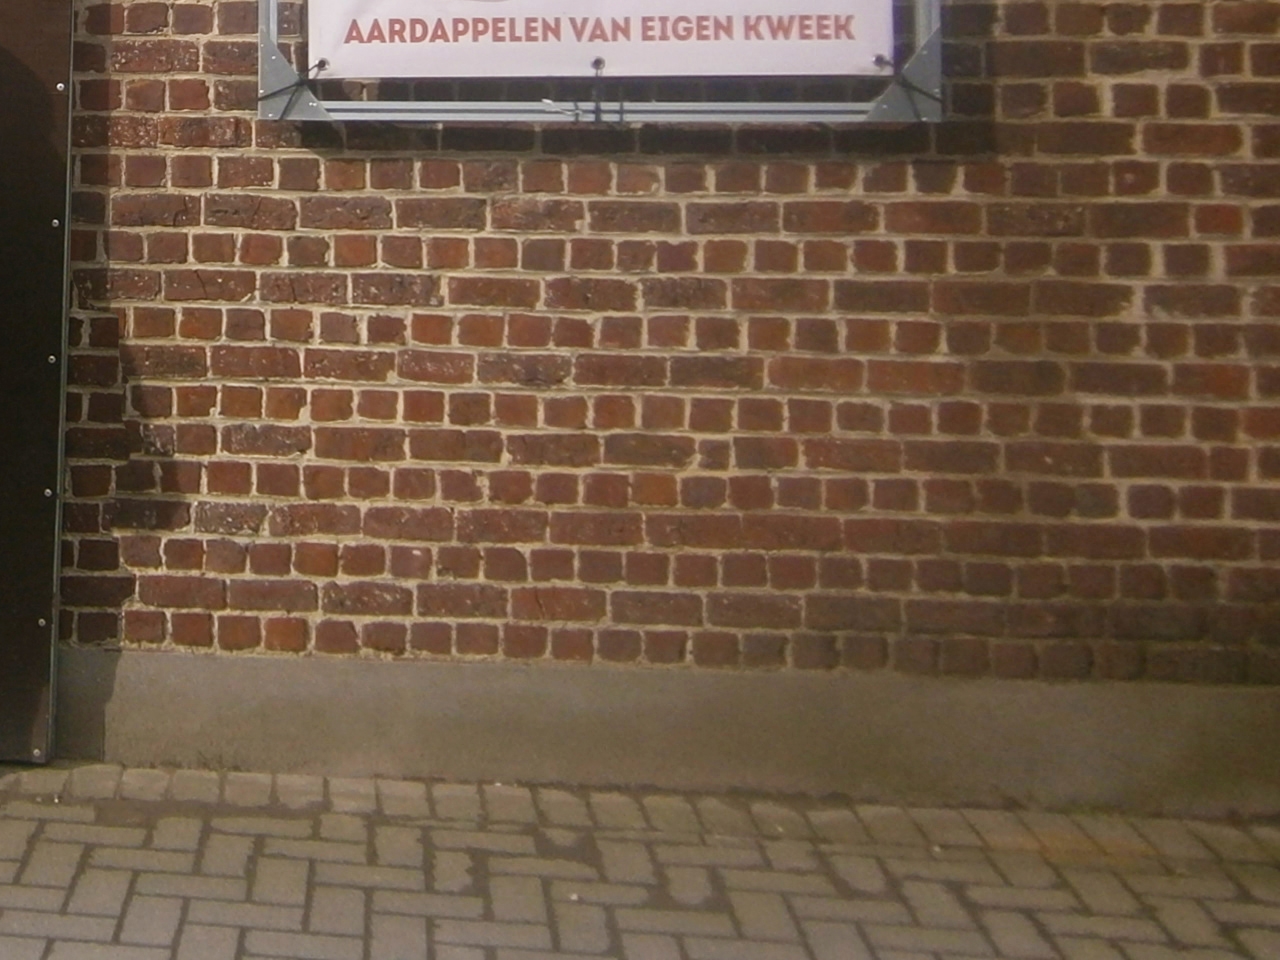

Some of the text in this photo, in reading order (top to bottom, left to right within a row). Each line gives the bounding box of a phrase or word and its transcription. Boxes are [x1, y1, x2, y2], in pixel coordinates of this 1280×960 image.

[343, 14, 856, 44] AARDAPPELEN VAN EIGEN KWEEK
